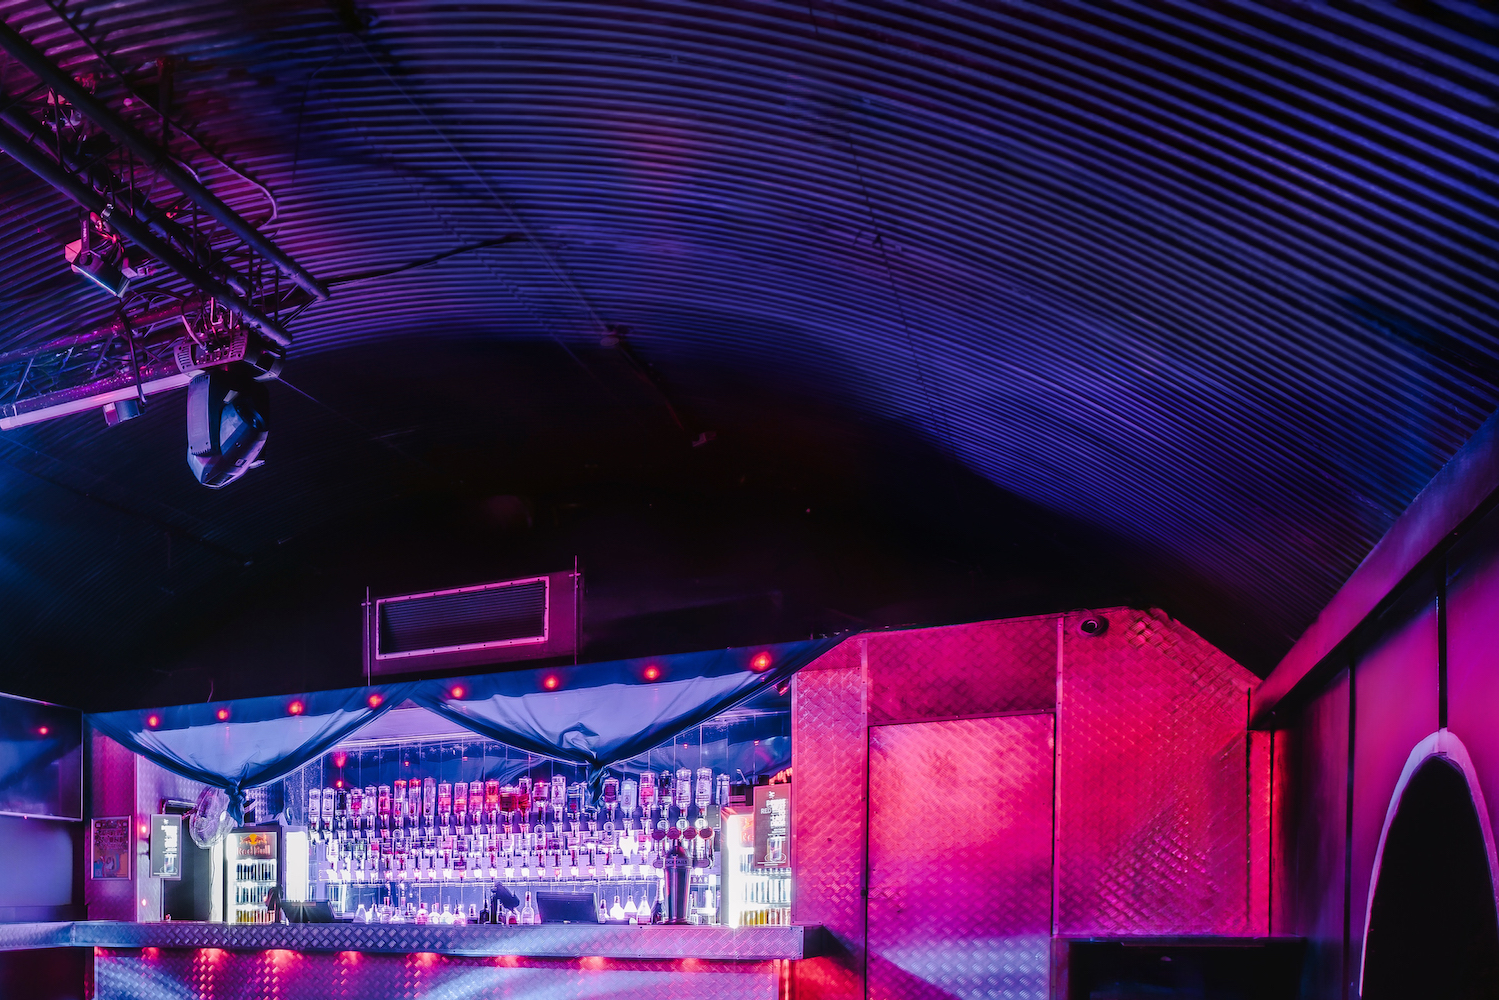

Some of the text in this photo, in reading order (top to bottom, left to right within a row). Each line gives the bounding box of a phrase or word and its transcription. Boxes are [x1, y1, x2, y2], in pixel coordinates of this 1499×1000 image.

[741, 831, 754, 842] Re
[236, 844, 270, 856] Red Bull
